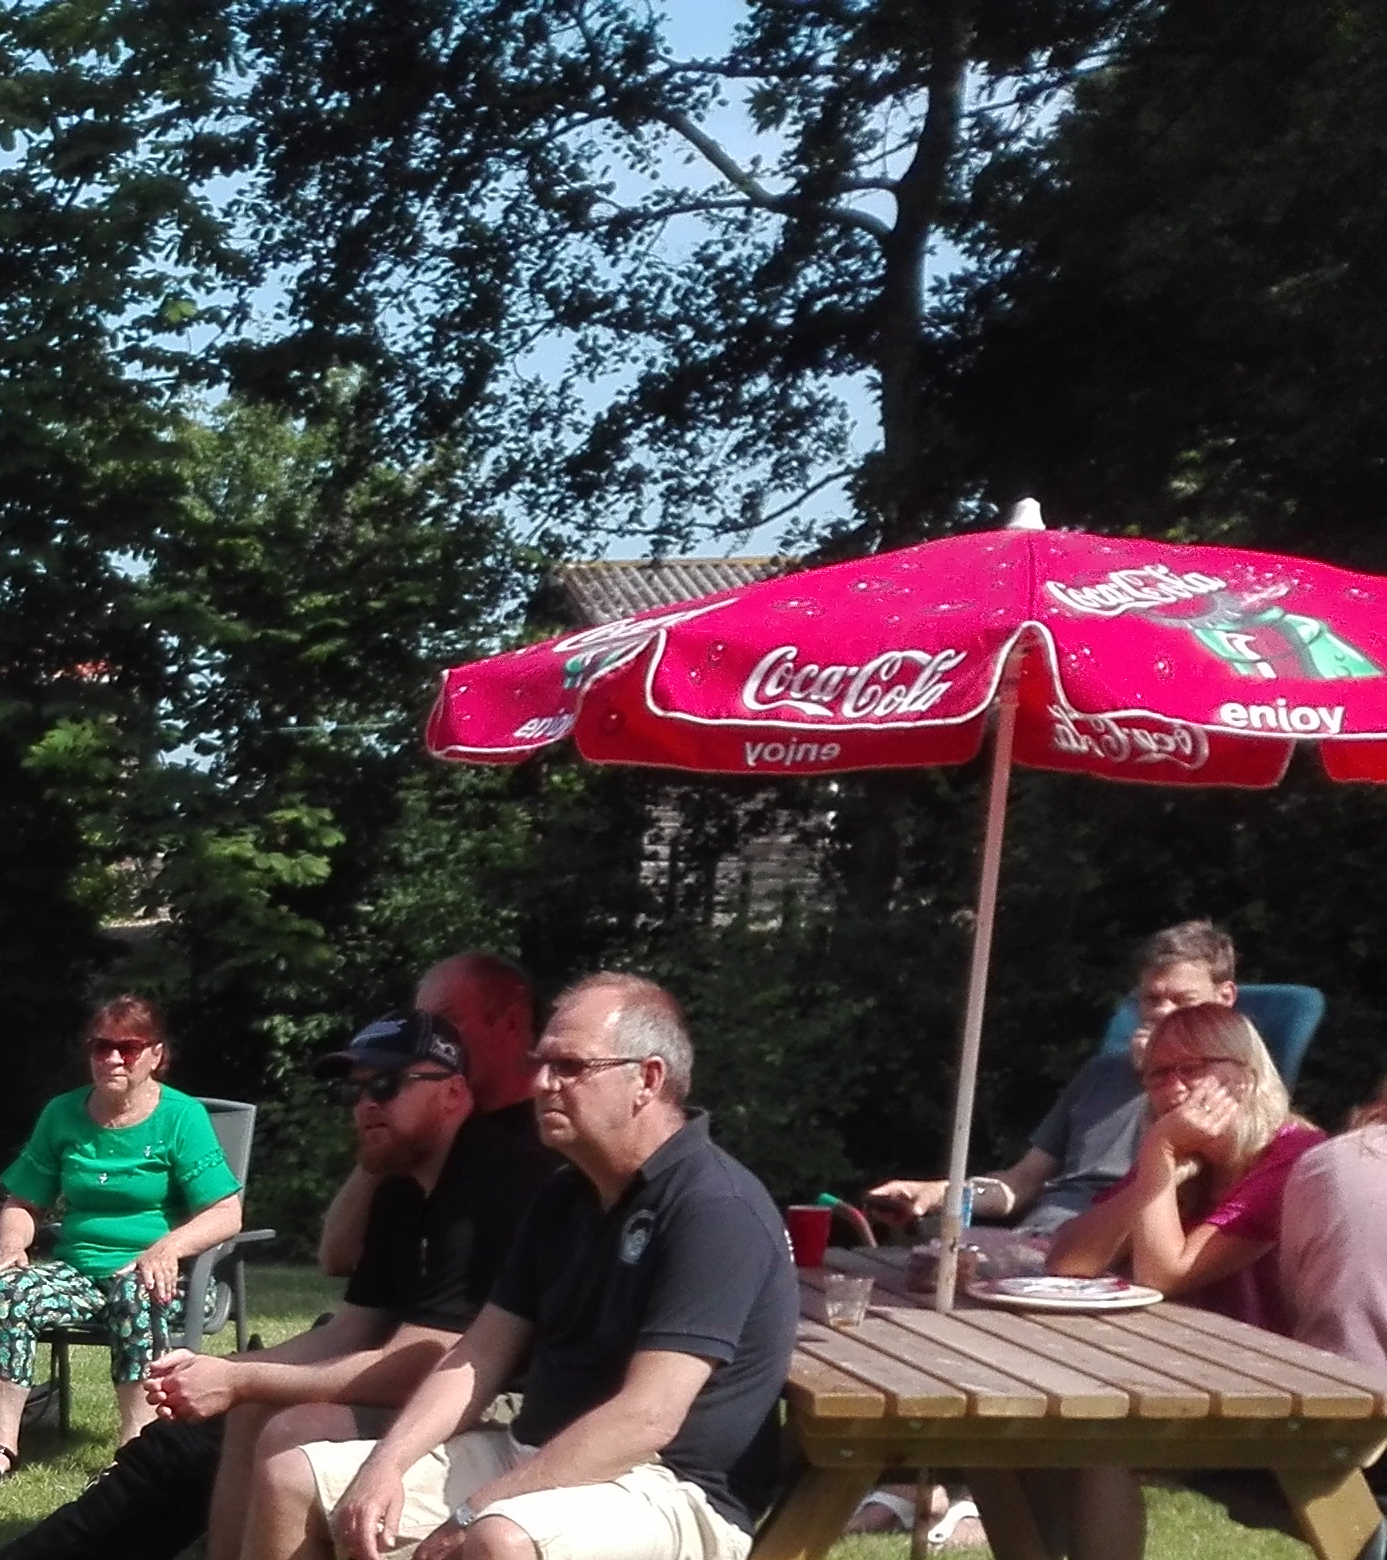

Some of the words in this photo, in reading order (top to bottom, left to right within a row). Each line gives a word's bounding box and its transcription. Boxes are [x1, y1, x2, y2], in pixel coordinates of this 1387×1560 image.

[1044, 563, 1227, 616] Coca-Cola
[742, 645, 969, 718] Coca-Cola
[1219, 697, 1346, 735] enjoy
